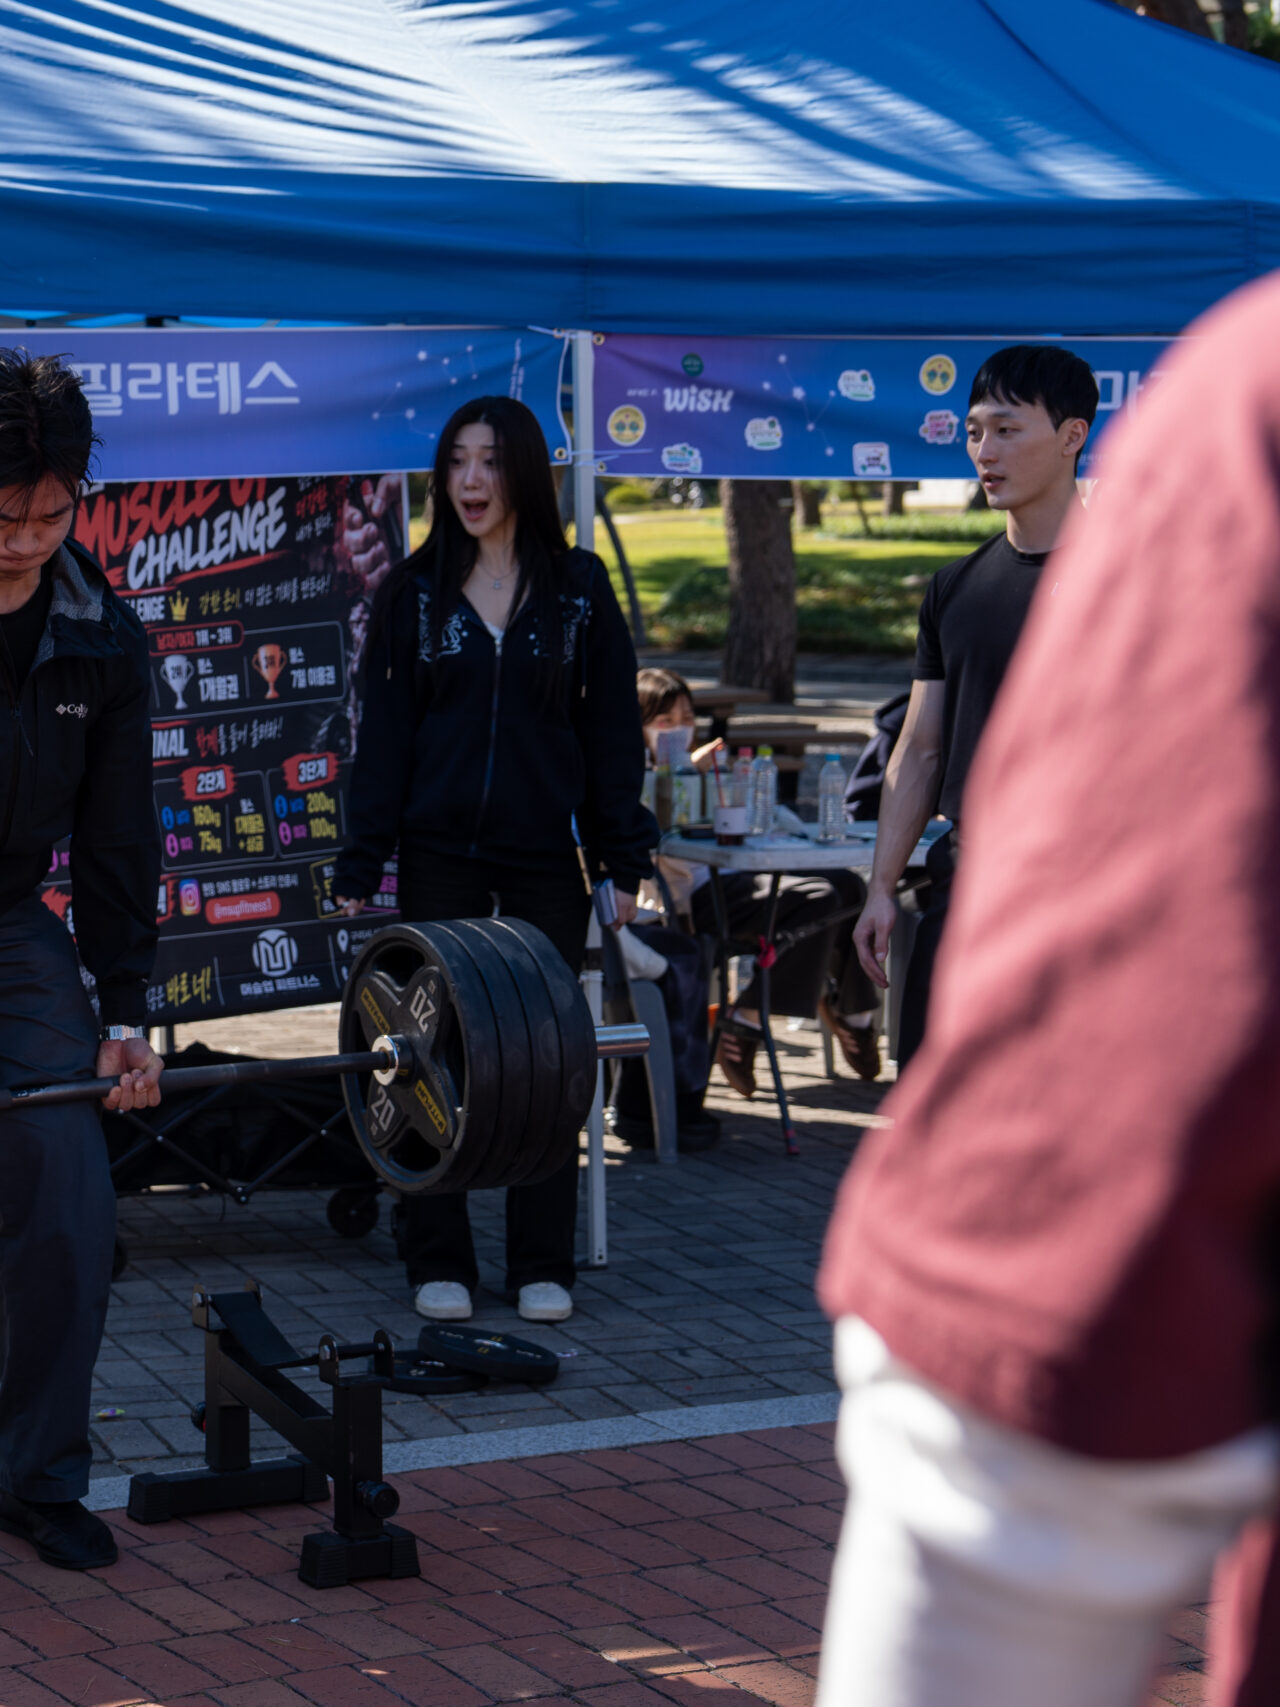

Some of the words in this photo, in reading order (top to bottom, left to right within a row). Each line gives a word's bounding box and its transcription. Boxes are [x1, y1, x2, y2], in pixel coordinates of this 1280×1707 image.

[80, 360, 300, 416] 필라테스
[127, 487, 287, 591] CHALLENGE
[152, 728, 189, 759] INAL
[166, 971, 193, 1008] 바로
[239, 979, 276, 997] 머슬업
[276, 973, 321, 992] 피트니스
[370, 1085, 396, 1132] 20
